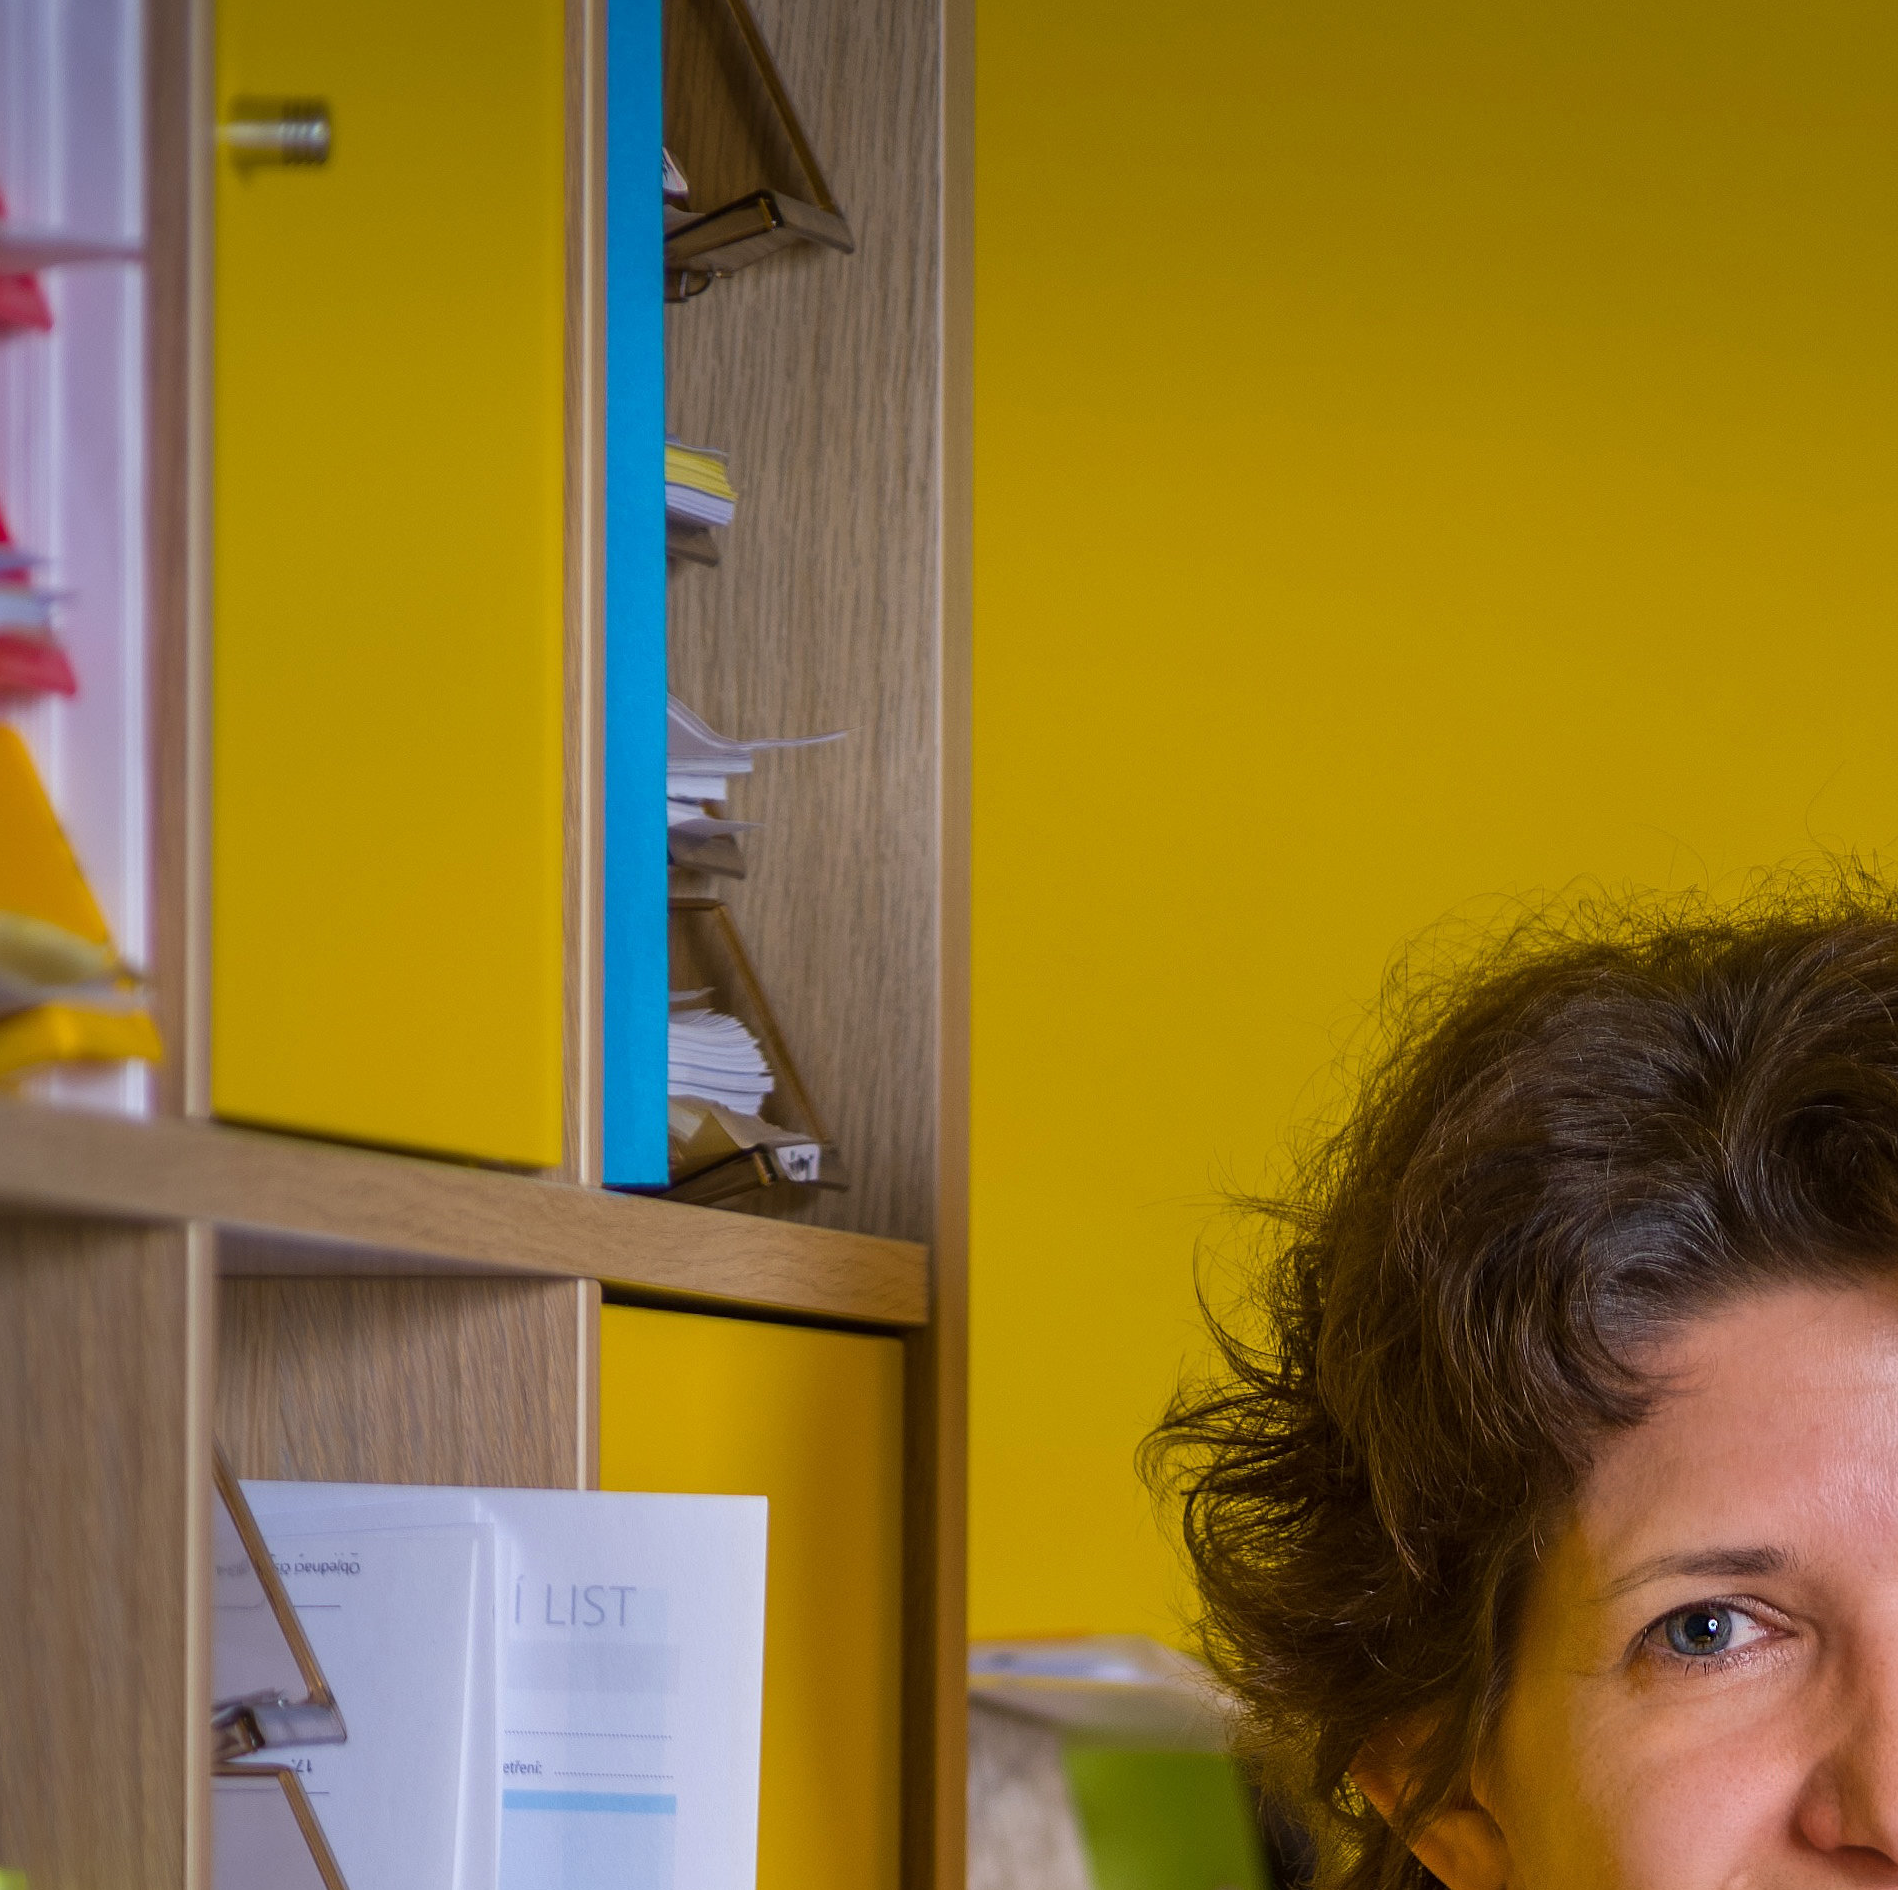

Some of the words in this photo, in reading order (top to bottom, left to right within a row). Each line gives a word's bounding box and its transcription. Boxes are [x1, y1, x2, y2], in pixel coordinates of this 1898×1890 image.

[294, 1558, 361, 1576] Objednací
[544, 1583, 637, 1627] LIST
[291, 1758, 313, 1773] 17.
